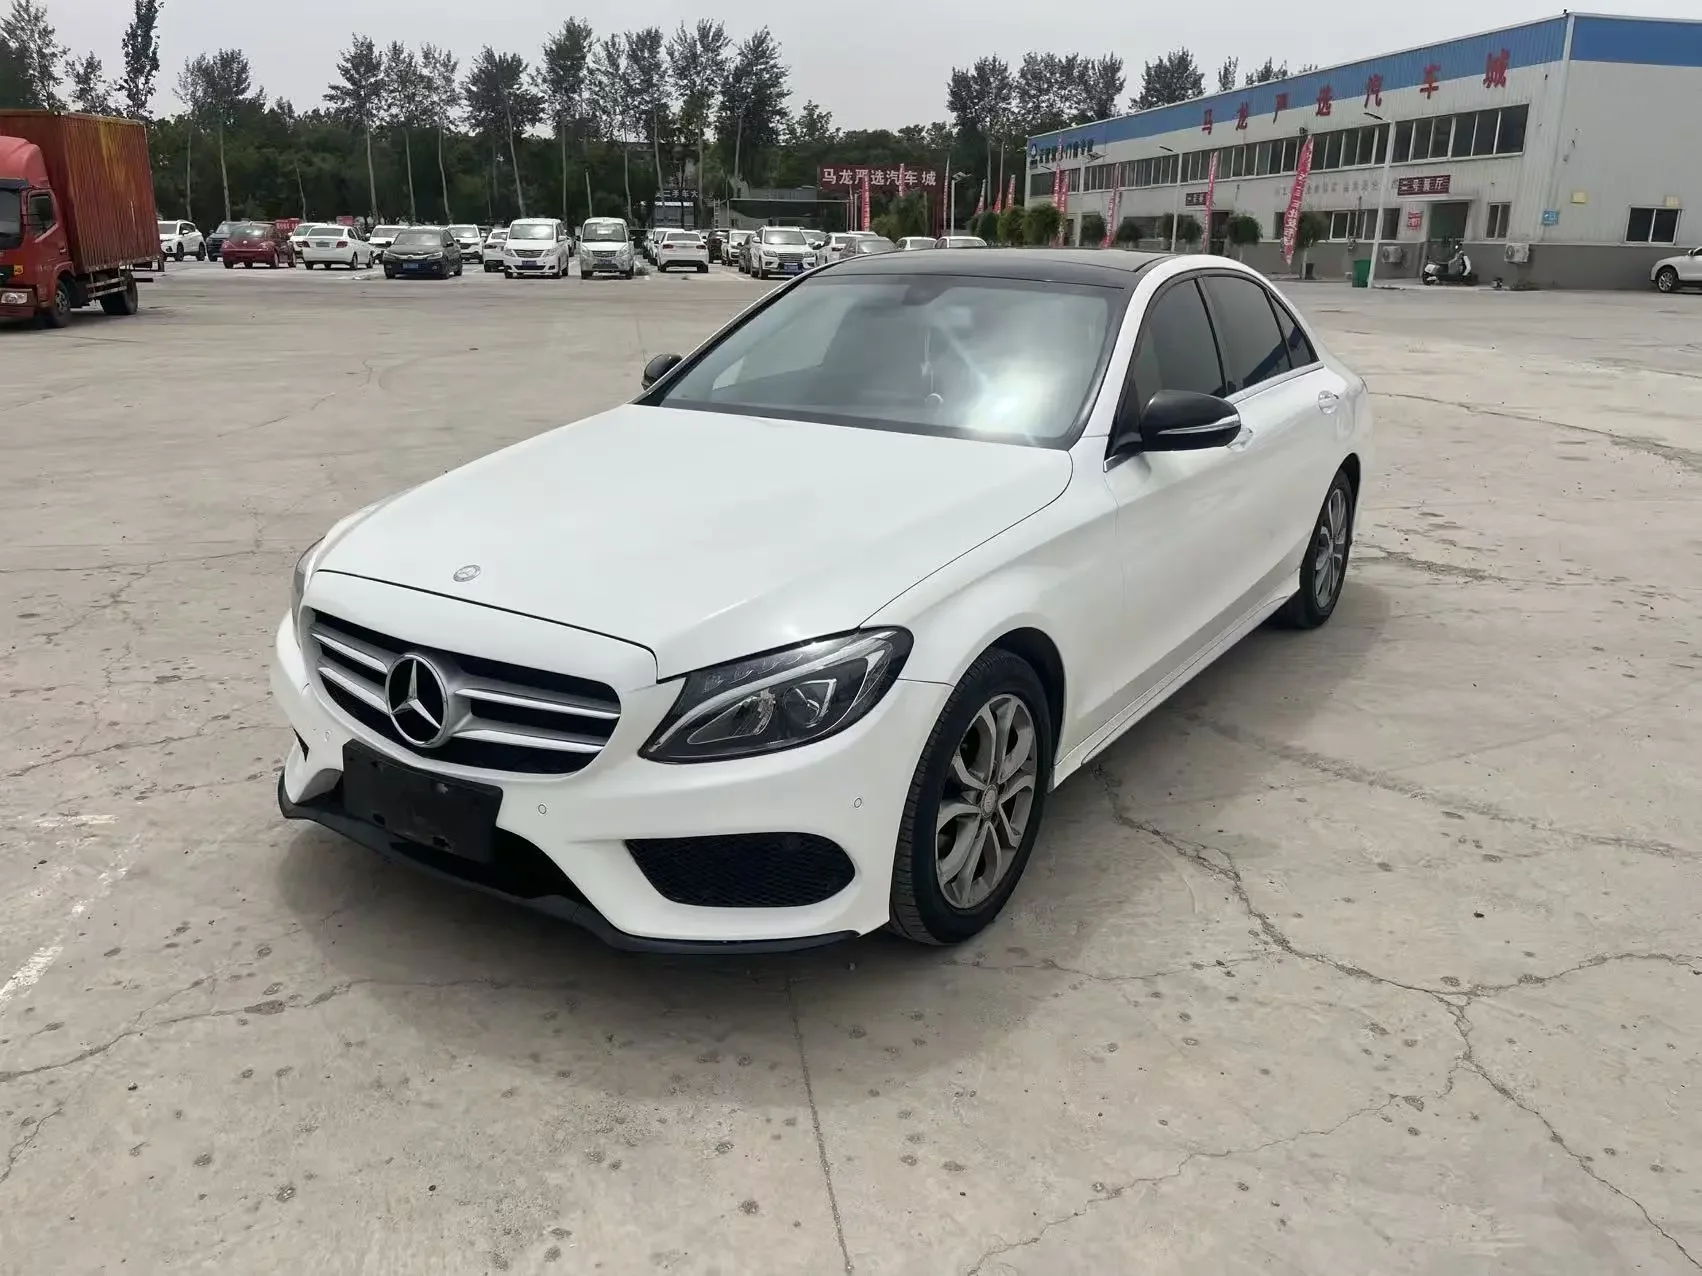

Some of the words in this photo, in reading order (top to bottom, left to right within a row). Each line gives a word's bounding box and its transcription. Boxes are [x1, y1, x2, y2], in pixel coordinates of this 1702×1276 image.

[1202, 48, 1509, 135] 马龙严选汽车城
[822, 168, 937, 186] 马龙严选汽车城
